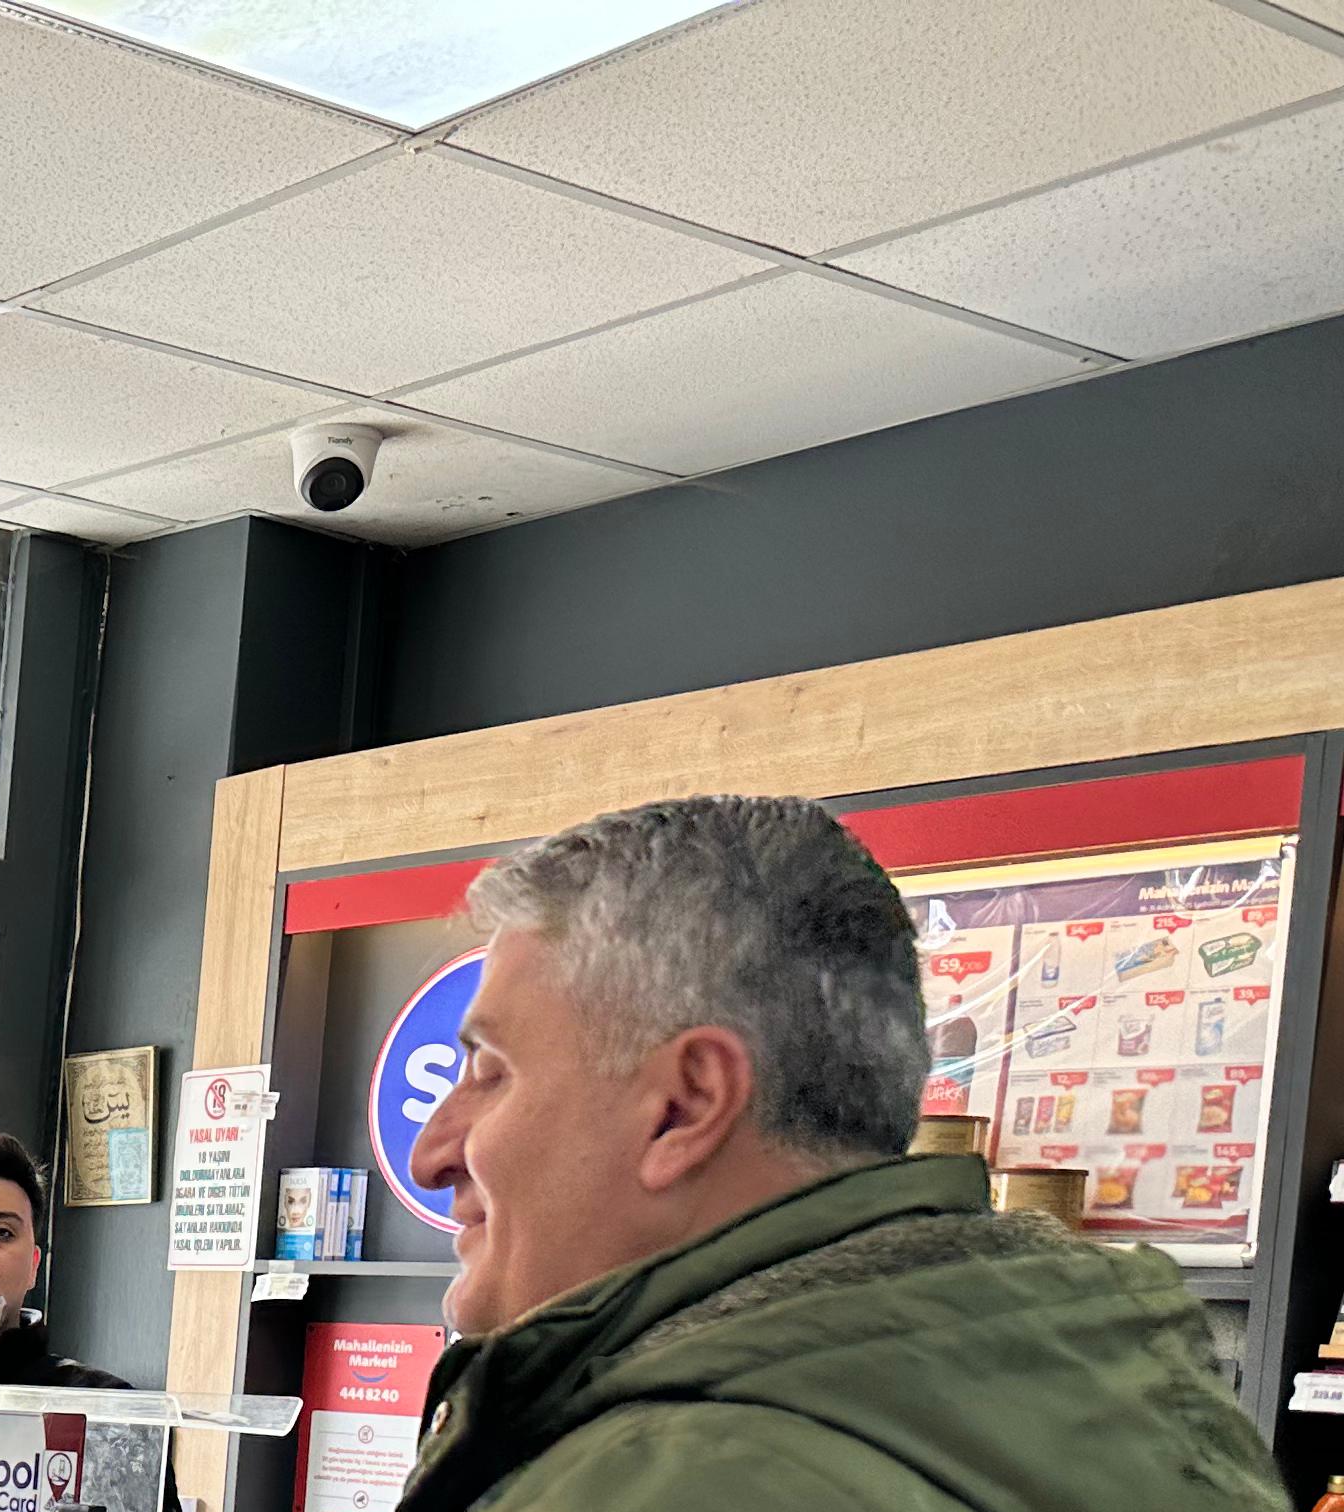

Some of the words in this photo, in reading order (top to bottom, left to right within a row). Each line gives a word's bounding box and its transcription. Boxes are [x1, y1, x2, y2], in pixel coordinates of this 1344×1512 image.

[189, 1128, 213, 1144] YASAL
[333, 1339, 413, 1354] Mahallenizin
[348, 1354, 397, 1369] Marketi
